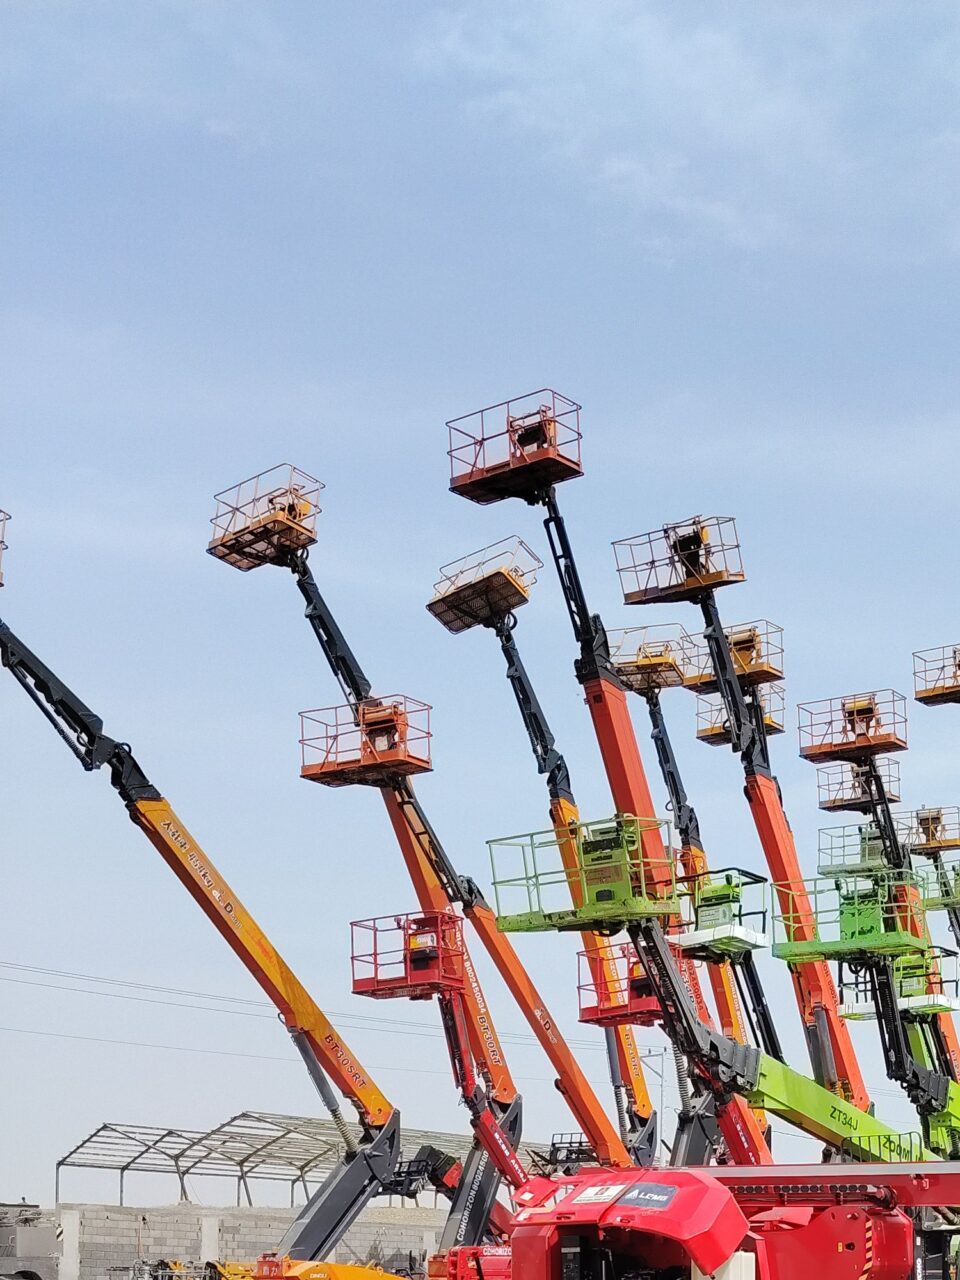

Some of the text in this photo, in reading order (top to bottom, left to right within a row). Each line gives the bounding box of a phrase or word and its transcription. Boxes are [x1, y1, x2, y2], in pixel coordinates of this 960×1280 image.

[683, 959, 705, 1011] 002450034
[478, 1015, 502, 1066] BT30RT
[736, 1011, 748, 1045] 80024500
[324, 1034, 367, 1089] BT30SRT
[829, 1105, 859, 1131] ZT34J
[456, 1151, 489, 1242] CDHORIZON 80024500
